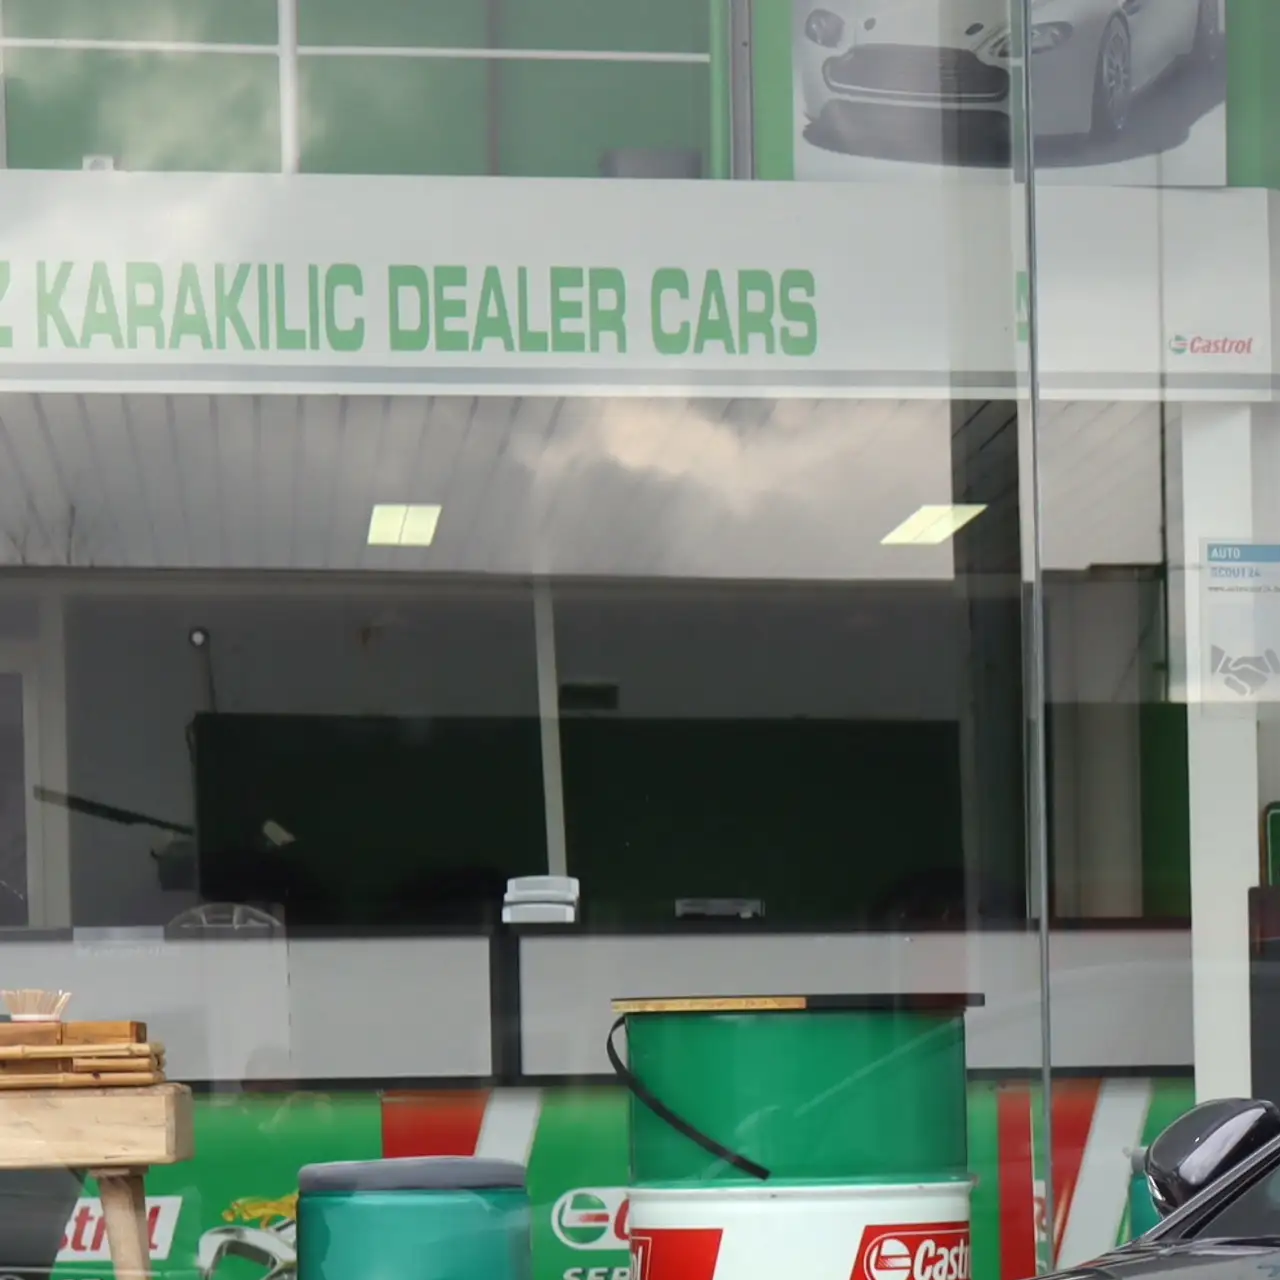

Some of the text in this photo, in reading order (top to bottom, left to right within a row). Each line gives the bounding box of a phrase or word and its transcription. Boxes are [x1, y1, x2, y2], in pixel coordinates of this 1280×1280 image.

[36, 261, 365, 352] KARAKILIC
[388, 265, 627, 354] DEALER
[650, 268, 818, 357] CARS
[1188, 335, 1254, 355] Castrol
[1210, 547, 1241, 559] AUTO
